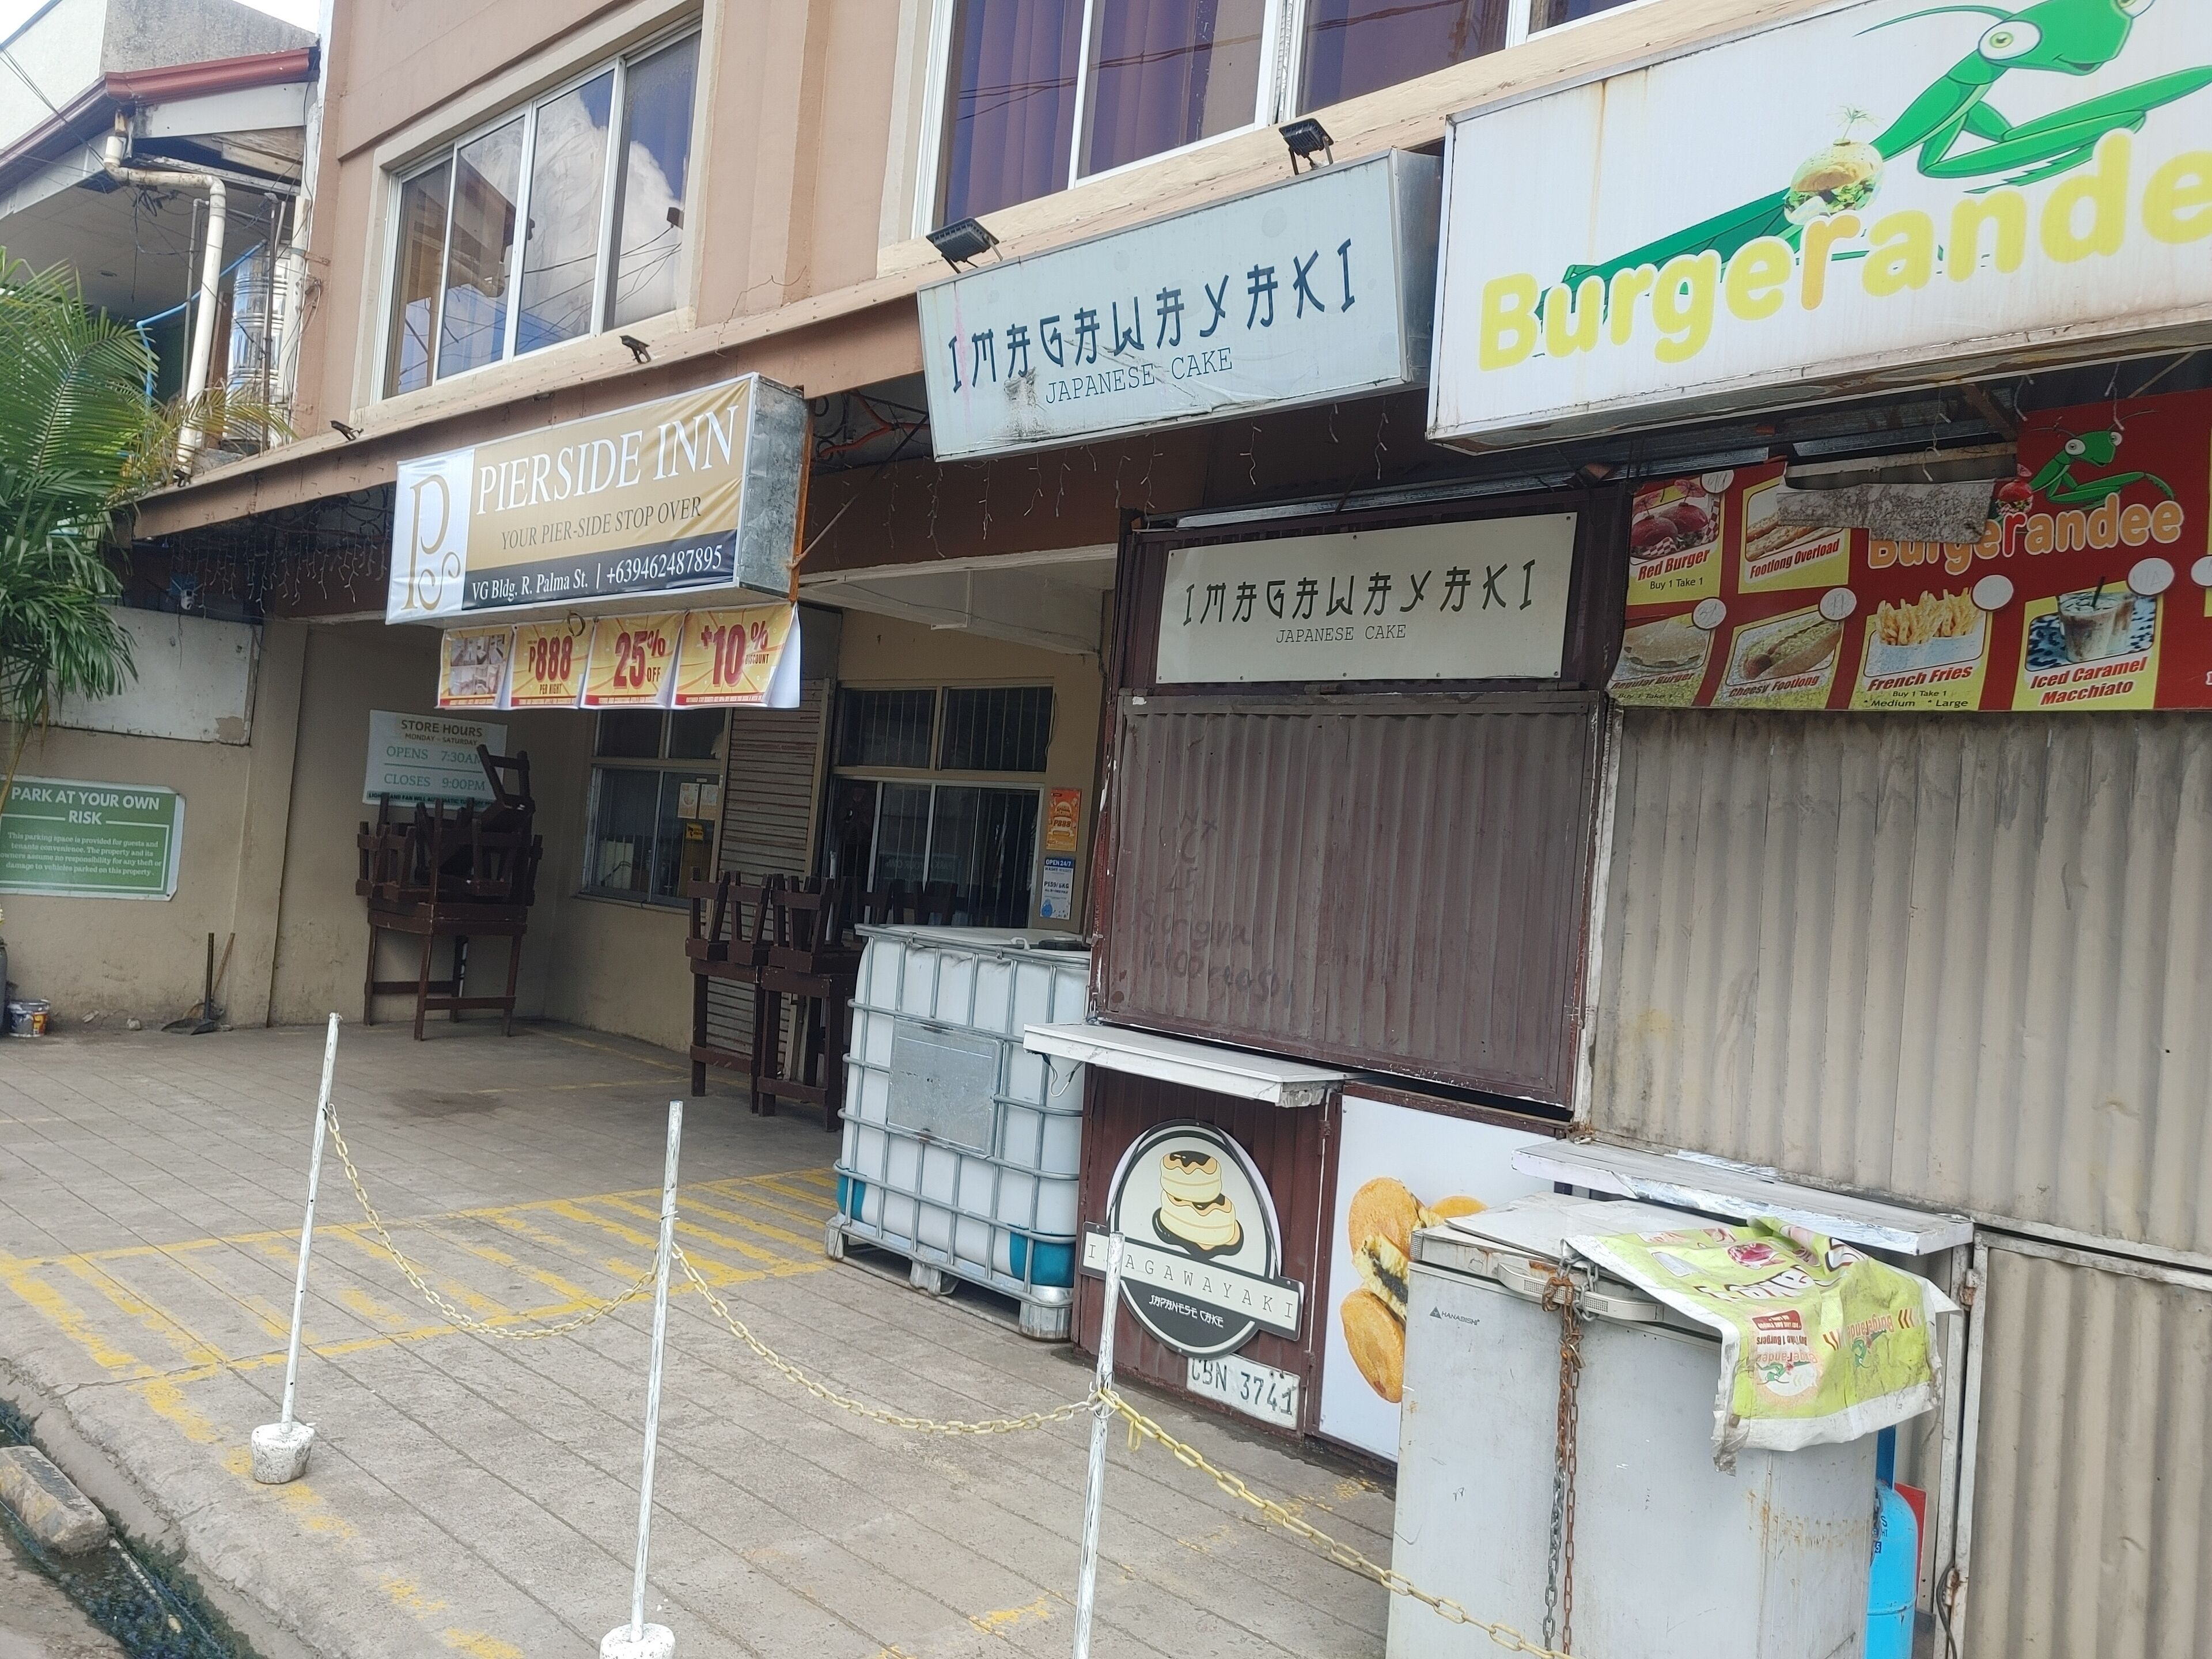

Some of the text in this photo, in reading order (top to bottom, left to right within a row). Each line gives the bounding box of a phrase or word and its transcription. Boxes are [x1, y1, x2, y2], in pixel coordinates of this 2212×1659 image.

[949, 238, 1356, 393] IMAGAWAYAKI
[1046, 348, 1233, 404] JAPANESE CAKE
[476, 406, 738, 515] PIERSIDE INN
[502, 496, 702, 550] YOUR PIER-SIDE STOP OVER
[1638, 548, 1710, 581] Red Burger
[1749, 538, 1840, 579] Footlong Overload
[472, 582, 488, 601] VG
[491, 578, 518, 603] Bldg.
[521, 577, 533, 595] R.
[536, 571, 570, 594] Palma
[573, 570, 588, 589] St.
[606, 544, 723, 585] +639462487895
[1183, 559, 1535, 626] IMAGAWAYAKI
[1650, 581, 1666, 590] Buy
[1676, 578, 1695, 587] Take
[1276, 624, 1406, 643] JAPANESE CAKE
[613, 628, 666, 690] 25%
[745, 654, 769, 665] DISCOUNT
[647, 667, 661, 682] OFF
[1655, 673, 1695, 684] Burger
[1867, 666, 1973, 691] French Fries
[2030, 657, 2148, 689] Iced Caramel
[539, 683, 562, 695] PER NIGHT
[1729, 676, 1820, 698] Cheesy Footlong
[2040, 681, 2134, 705] Macchiato
[1936, 700, 1968, 708] Large
[402, 719, 482, 737] STORE HOURS
[405, 733, 478, 746] MONDAY SATURDAY
[387, 746, 428, 759] OPENS
[384, 774, 485, 791] CLOSES 9:00PM
[12, 787, 160, 810] PARK AT YOUR OWN
[69, 810, 102, 825] RISK
[12, 842, 39, 851] tenants
[40, 844, 85, 853] convenience.
[101, 848, 130, 857] property
[25, 834, 52, 843] parking
[54, 836, 73, 844] space
[81, 837, 112, 846] provided
[123, 840, 145, 848] guests
[6, 861, 34, 872] damage
[44, 863, 73, 873] vehicles
[73, 865, 98, 874] parked
[108, 866, 122, 874] this
[65, 855, 112, 865] responsibility
[112, 856, 122, 864] for
[123, 858, 137, 866] any
[137, 858, 154, 866] theft
[1088, 1244, 1294, 1318] IAGAWAYAKI
[1148, 1294, 1224, 1329] JAPANESE CAKE
[1442, 1310, 1478, 1325] HANABISHI
[1756, 1335, 1781, 1345] Burgers
[1240, 1371, 1293, 1416] 3741
